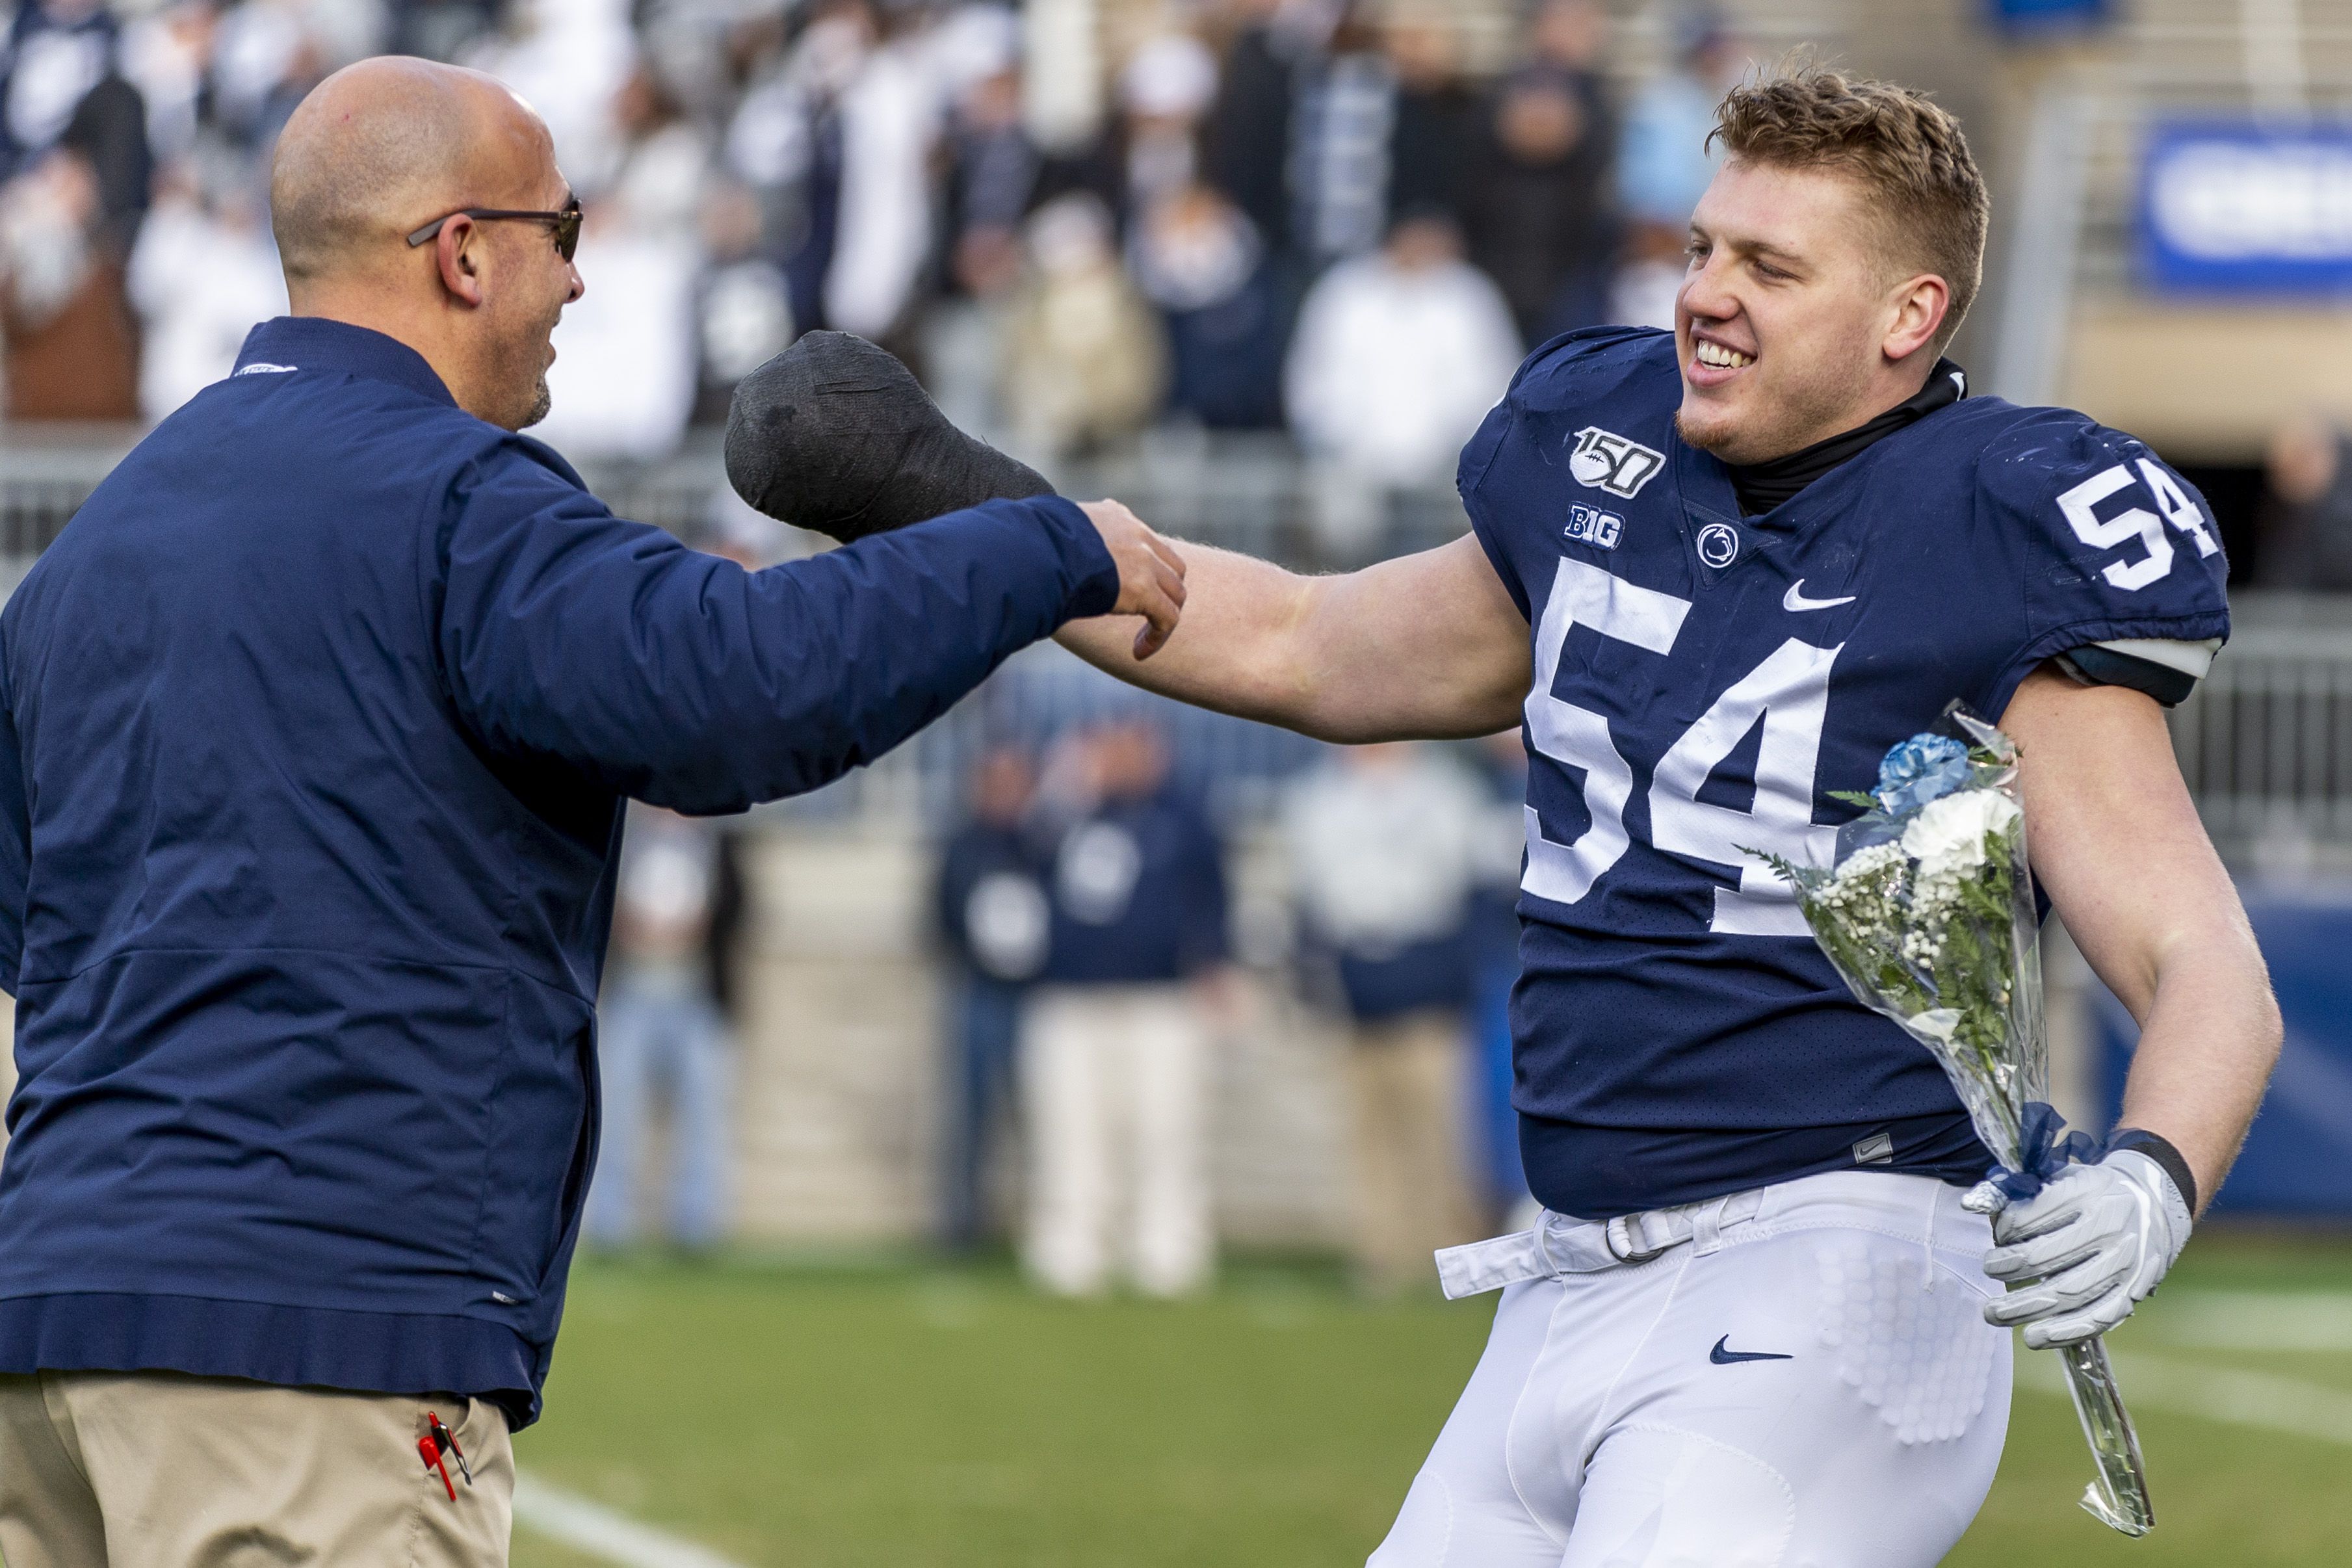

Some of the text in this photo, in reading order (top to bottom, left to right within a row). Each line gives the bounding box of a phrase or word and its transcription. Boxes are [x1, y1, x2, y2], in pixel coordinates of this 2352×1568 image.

[1573, 428, 1663, 497] 150
[1564, 505, 1621, 547] BIG
[2056, 458, 2219, 592] 54
[1520, 556, 1845, 937] 54
